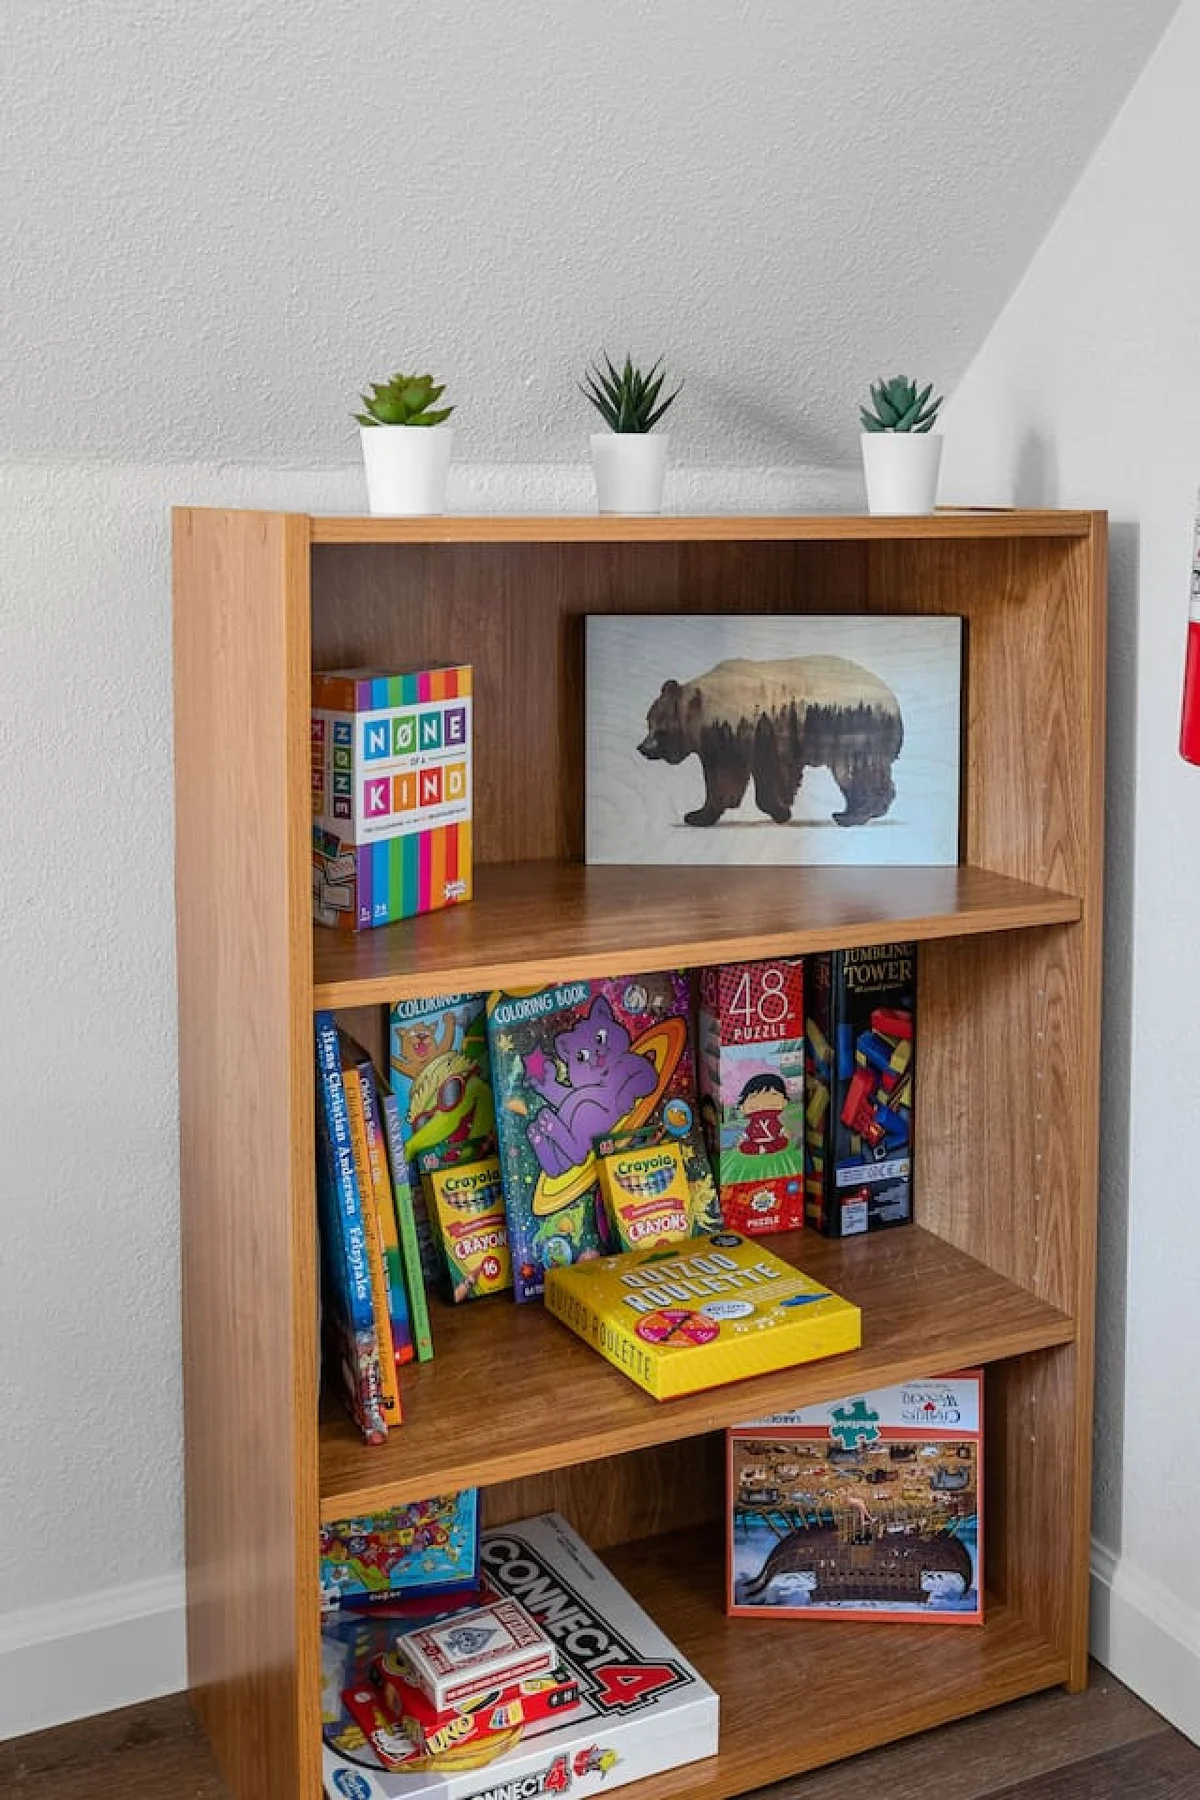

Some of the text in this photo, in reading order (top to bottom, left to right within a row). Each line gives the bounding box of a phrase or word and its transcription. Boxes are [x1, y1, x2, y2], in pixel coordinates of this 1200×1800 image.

[368, 767, 464, 814] KIND
[843, 960, 912, 988] TOWER
[397, 994, 461, 1018] COLORING
[494, 986, 588, 1023] COLORING BOOK
[729, 969, 789, 1026] 48
[734, 1023, 787, 1042] PUZZLE
[321, 1030, 337, 1069] Hans
[329, 1072, 347, 1142] Christian
[338, 1147, 357, 1216] Andersen
[618, 1154, 673, 1174] Crayola
[445, 1170, 500, 1191] Crayola
[629, 1213, 688, 1242] CRAYONS
[455, 1231, 507, 1259] CRAYON
[484, 1262, 498, 1276] 16
[619, 1252, 738, 1288] QUIZOO
[622, 1262, 781, 1314] ROULETTE
[480, 1539, 628, 1668] CONNECT
[592, 1664, 677, 1704] 4
[545, 1756, 567, 1793] 4
